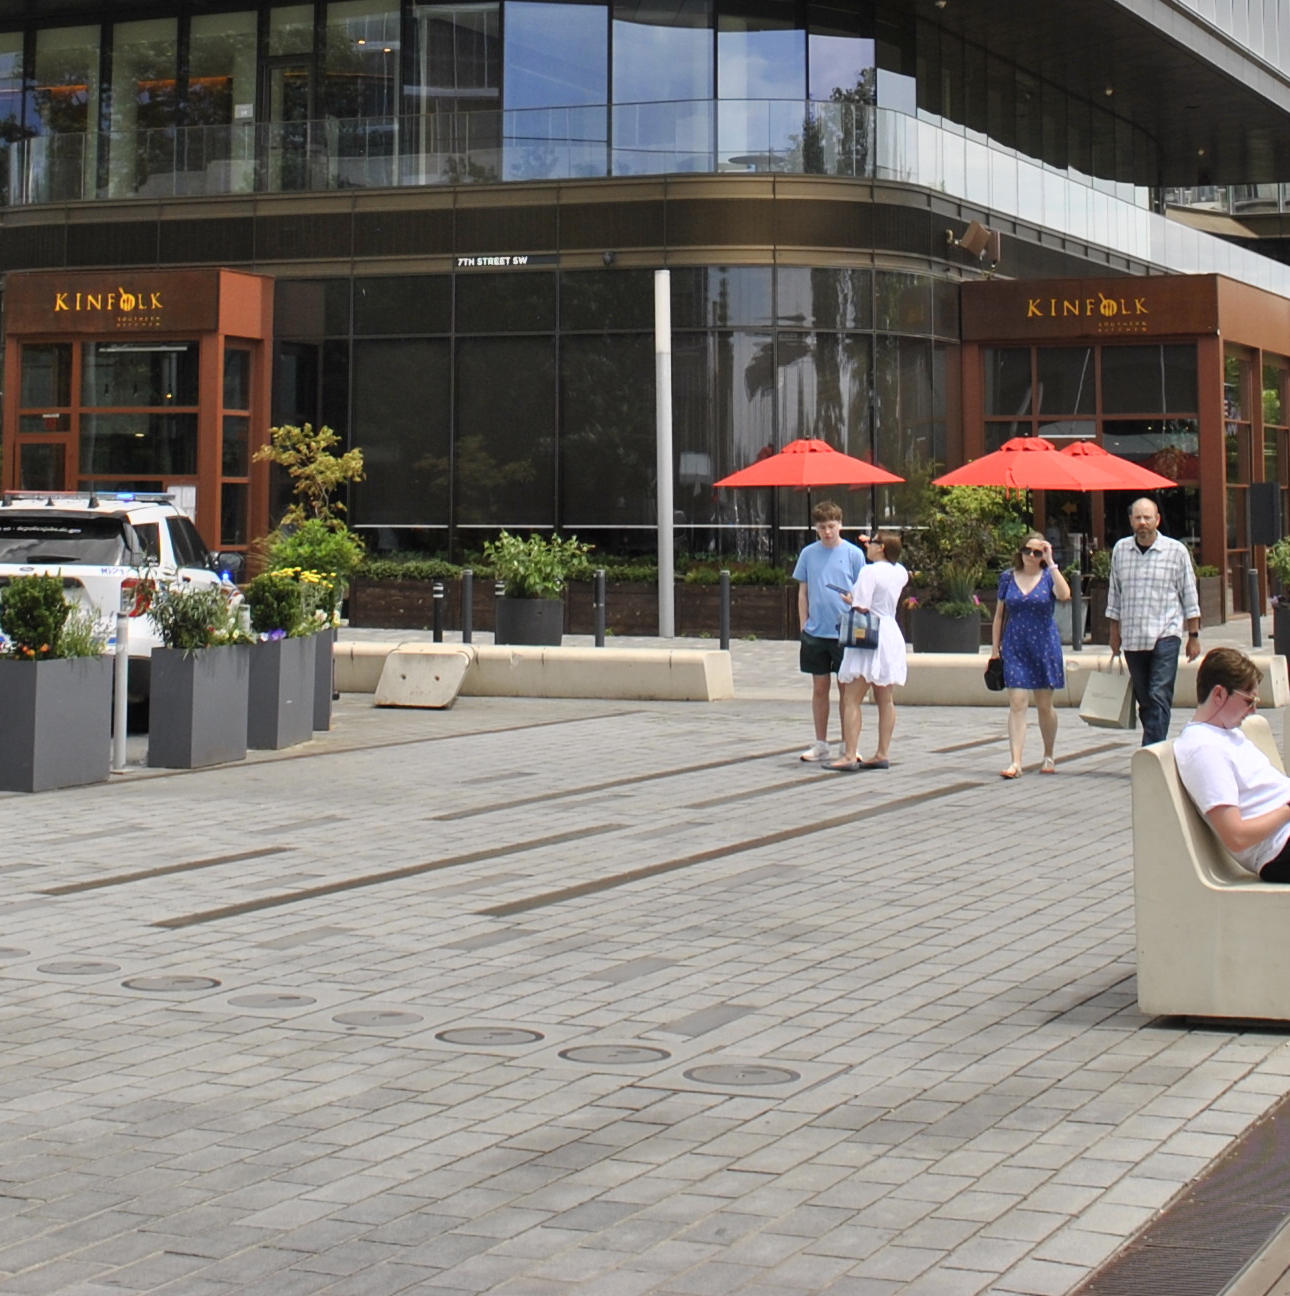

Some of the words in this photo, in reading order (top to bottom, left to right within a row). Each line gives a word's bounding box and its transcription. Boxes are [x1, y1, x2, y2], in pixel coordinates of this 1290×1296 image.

[457, 257, 475, 266] 7TH
[476, 256, 511, 266] STREET
[512, 256, 528, 265] SW
[54, 287, 163, 312] KINFOLK
[1027, 292, 1148, 317] KINFOLK
